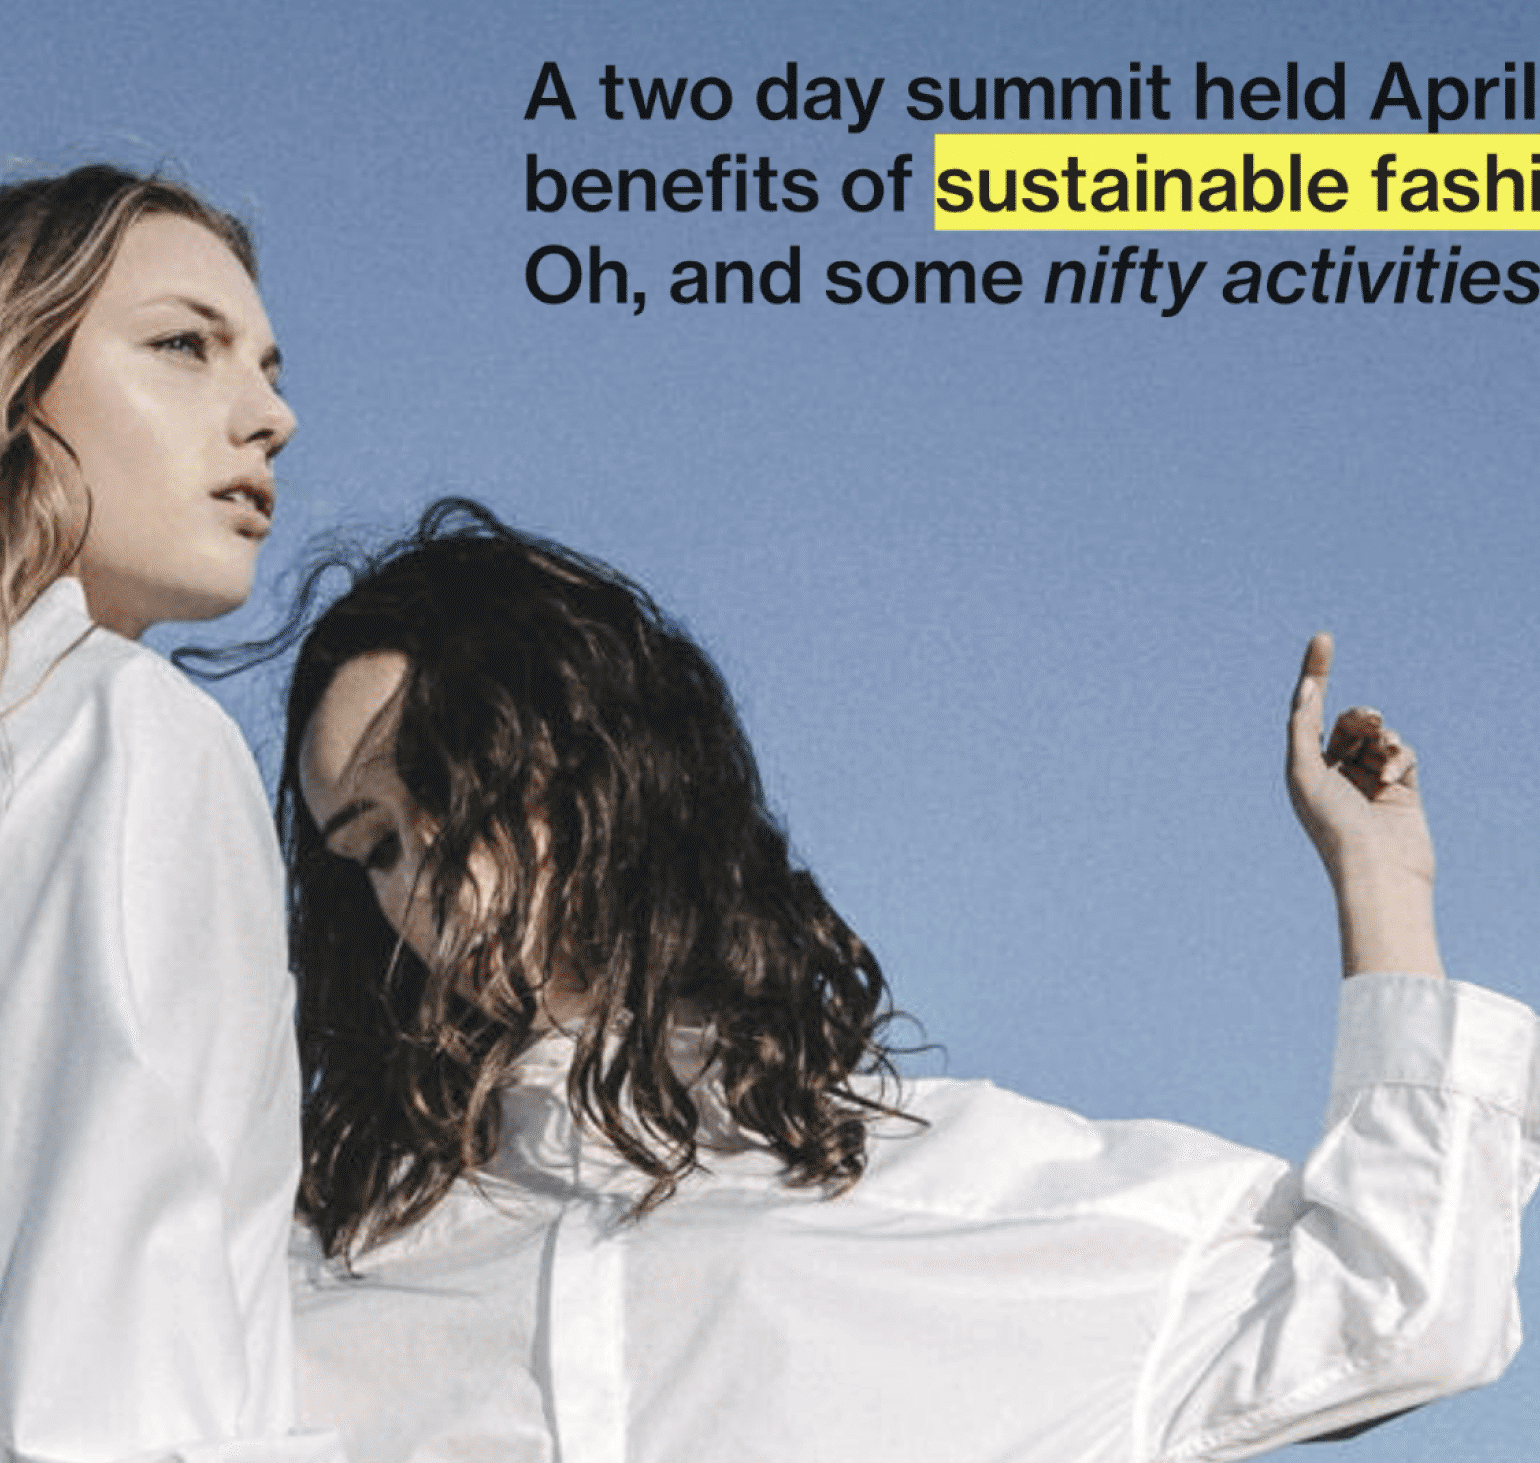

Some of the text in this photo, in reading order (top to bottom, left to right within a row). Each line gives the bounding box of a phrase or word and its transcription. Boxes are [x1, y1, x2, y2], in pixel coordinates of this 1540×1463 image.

[523, 61, 577, 121] A
[598, 64, 733, 121] two
[755, 61, 886, 134] day
[906, 61, 1172, 121] summit
[1196, 61, 1346, 121] held
[1369, 61, 1536, 134] April
[526, 153, 819, 213] benefits
[841, 153, 913, 213] of
[936, 154, 1348, 212] sustainable
[525, 244, 646, 317] Oh,
[669, 245, 801, 305] and
[825, 260, 1023, 305] some
[1044, 245, 1208, 318] nifty
